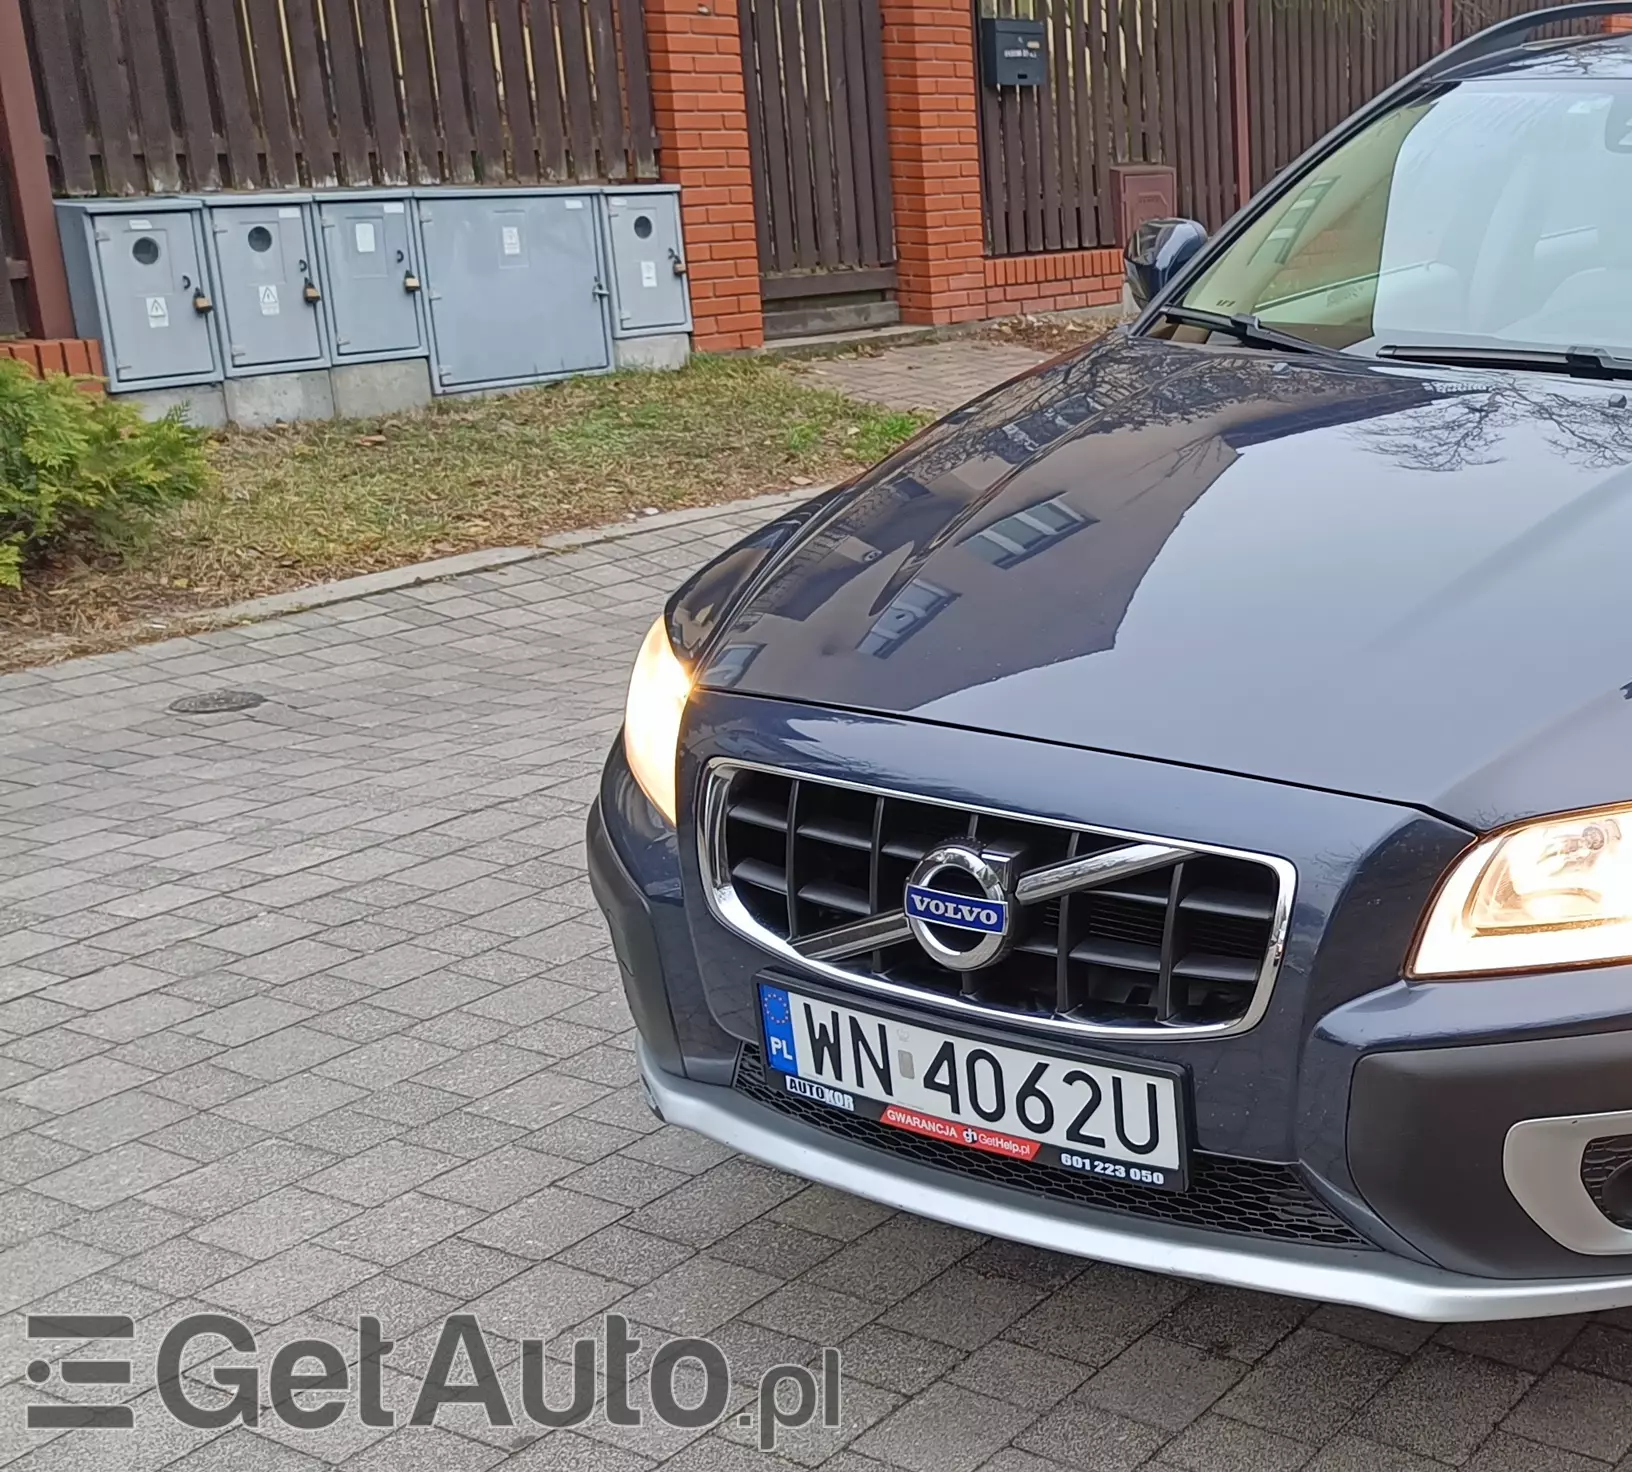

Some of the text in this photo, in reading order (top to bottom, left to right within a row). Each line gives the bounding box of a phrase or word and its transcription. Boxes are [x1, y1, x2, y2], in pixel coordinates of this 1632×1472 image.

[911, 893, 998, 925] VOLVO
[770, 1036, 793, 1060] PL
[803, 1002, 1159, 1155] WN 4062U
[886, 1109, 957, 1138] GWARANCJA
[978, 1132, 1031, 1156] GetHelp.pl
[1060, 1153, 1164, 1185] 601 223 050
